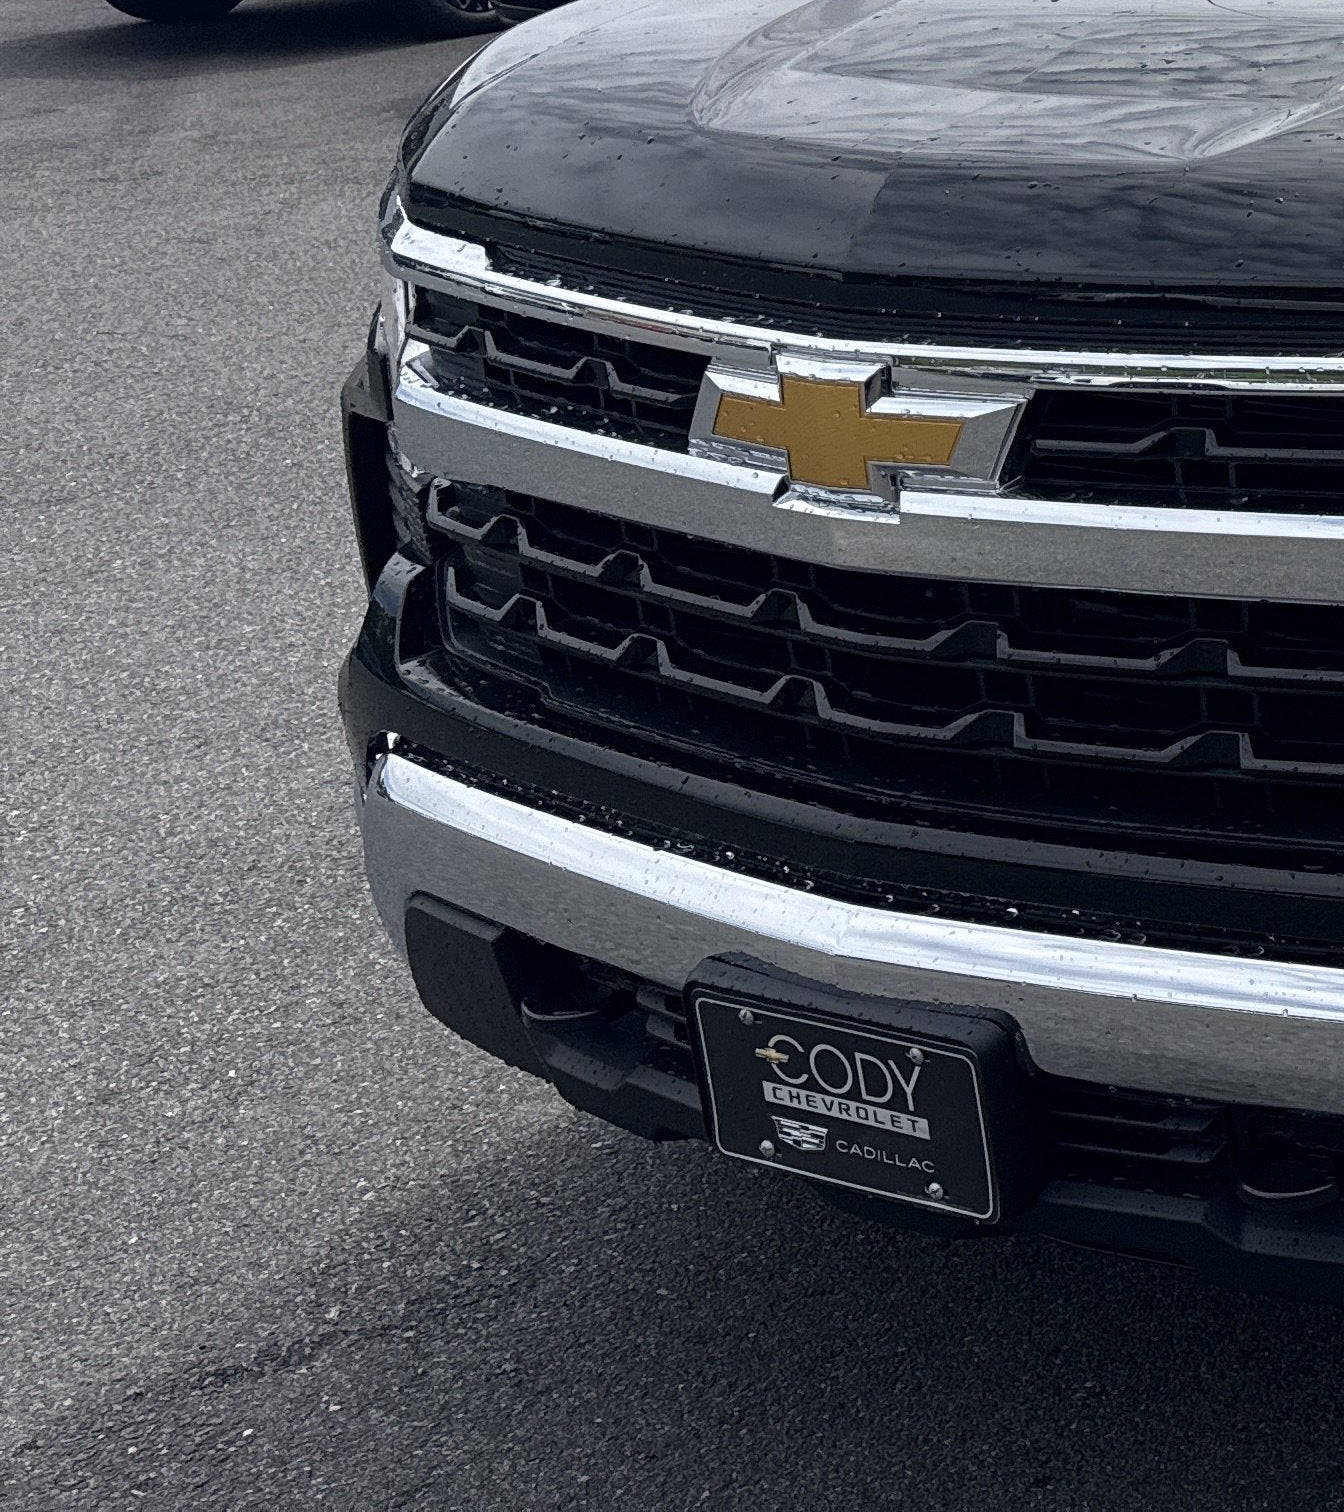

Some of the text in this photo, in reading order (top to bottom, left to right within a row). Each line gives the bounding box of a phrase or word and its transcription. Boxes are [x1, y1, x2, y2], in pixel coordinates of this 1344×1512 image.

[767, 1034, 921, 1112] CODY
[773, 1085, 920, 1134] CHEVROLET
[835, 1140, 935, 1173] CADILLAC
